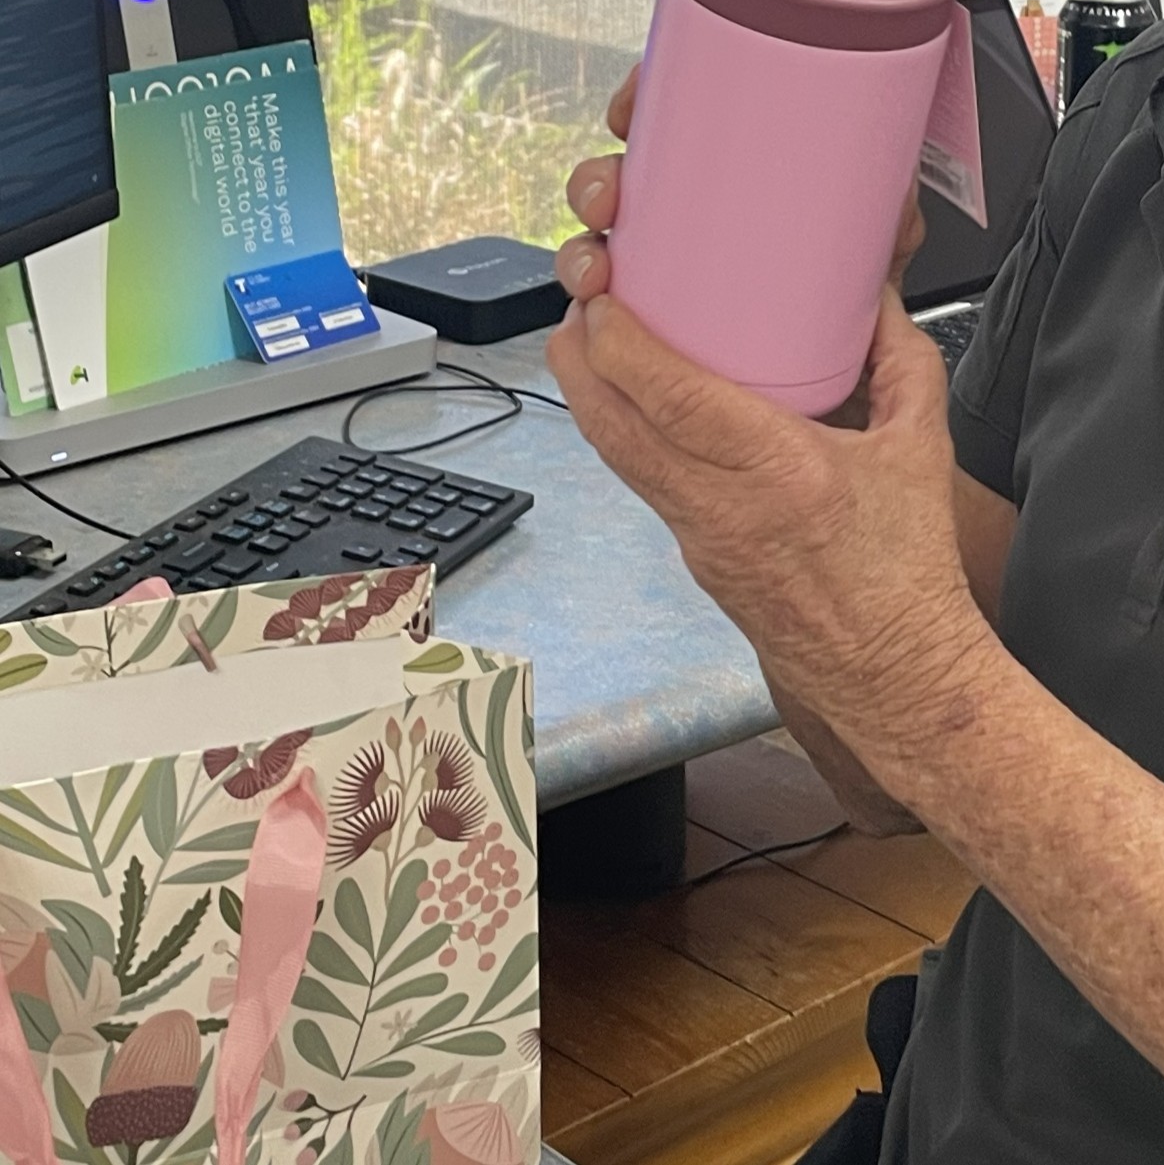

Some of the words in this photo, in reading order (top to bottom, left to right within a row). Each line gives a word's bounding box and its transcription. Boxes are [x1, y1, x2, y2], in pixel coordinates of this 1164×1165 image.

[203, 104, 230, 173] digital
[223, 100, 249, 188] connect
[262, 93, 283, 153] Make
[248, 155, 269, 201] year
[272, 156, 289, 198] this
[216, 176, 239, 238] world
[237, 190, 251, 213] to
[255, 205, 275, 243] you
[273, 200, 295, 247] year
[241, 217, 258, 254] the
